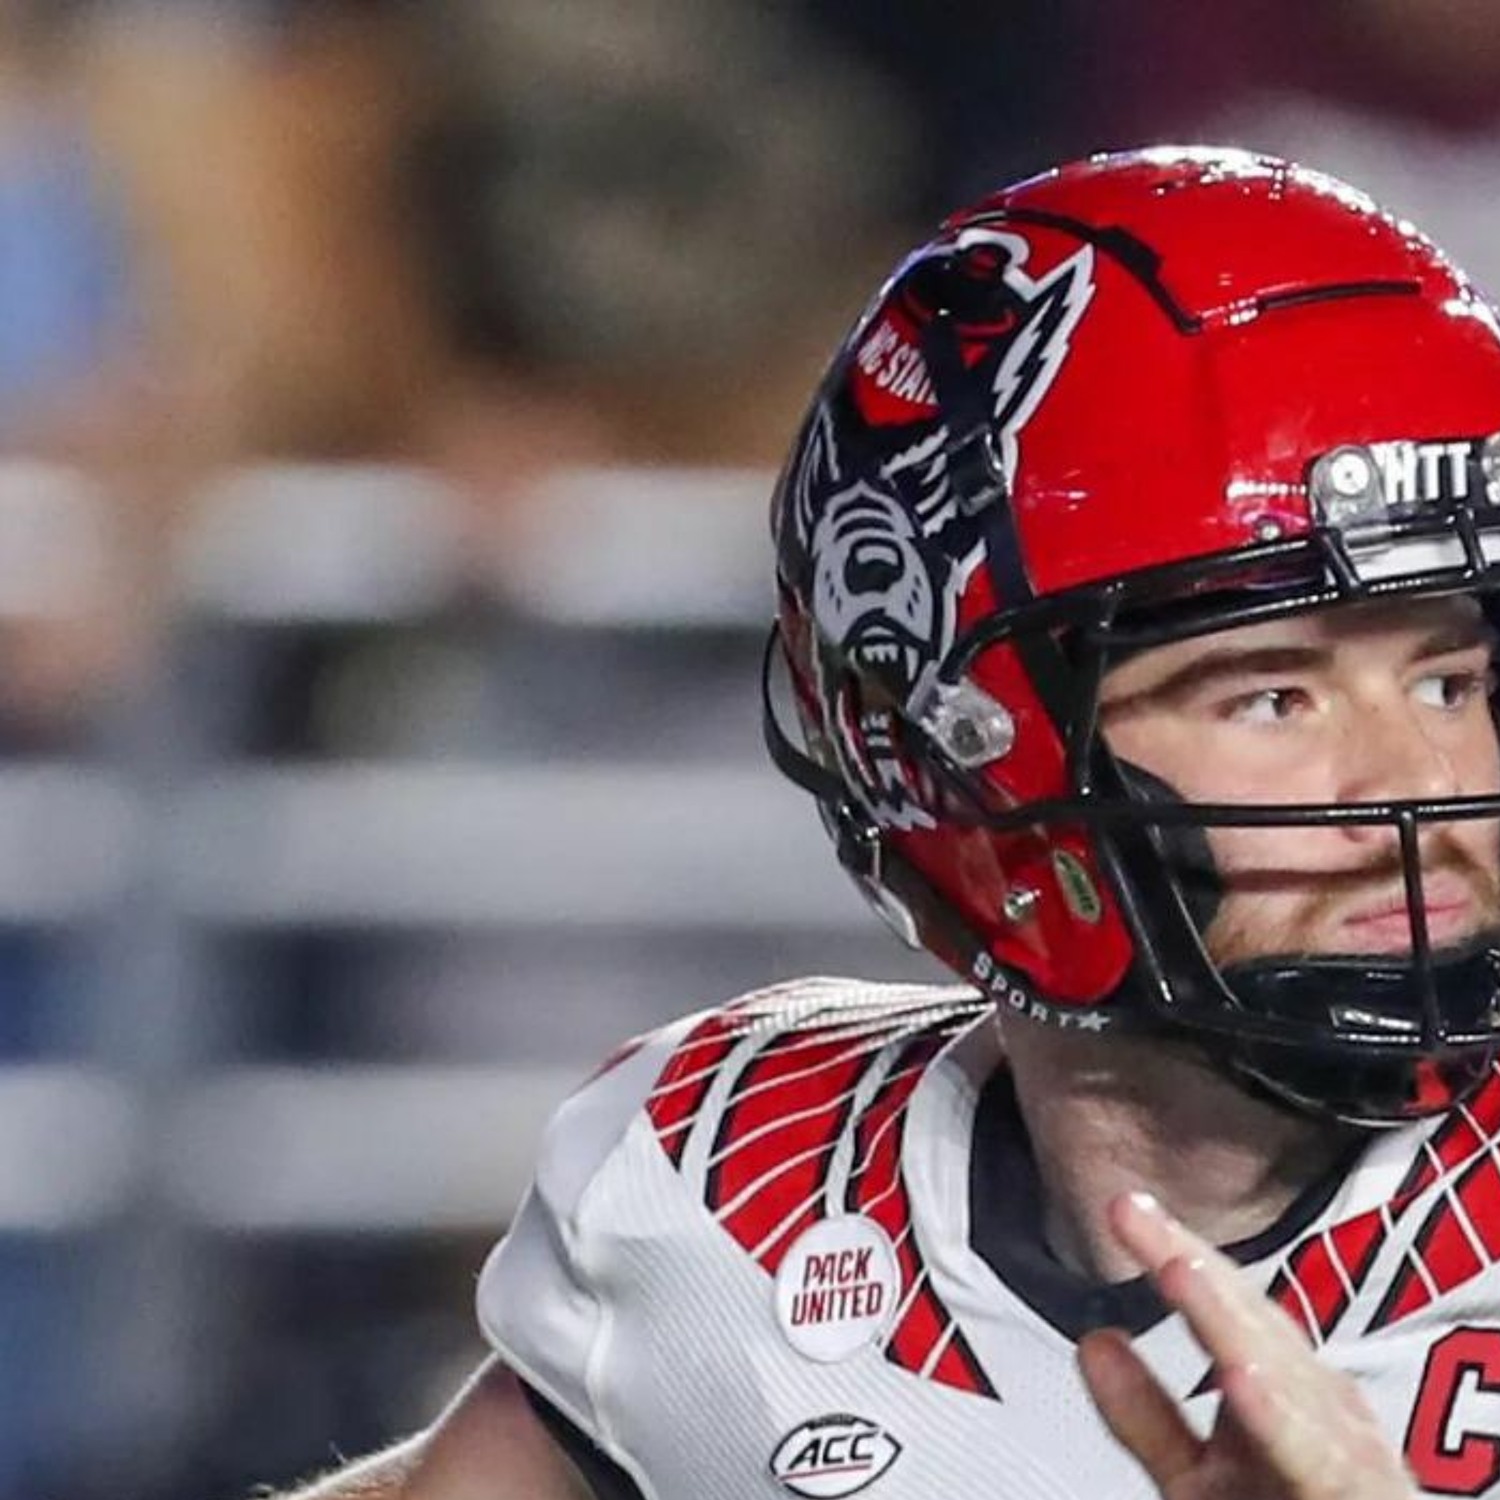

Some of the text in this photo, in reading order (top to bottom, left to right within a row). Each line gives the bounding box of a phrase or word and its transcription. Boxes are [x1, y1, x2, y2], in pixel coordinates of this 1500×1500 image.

[876, 342, 940, 405] STA
[973, 951, 1073, 1028] SPORT
[803, 1247, 873, 1289] PACK
[790, 1282, 883, 1326] UNITED
[787, 1430, 880, 1471] ACC
